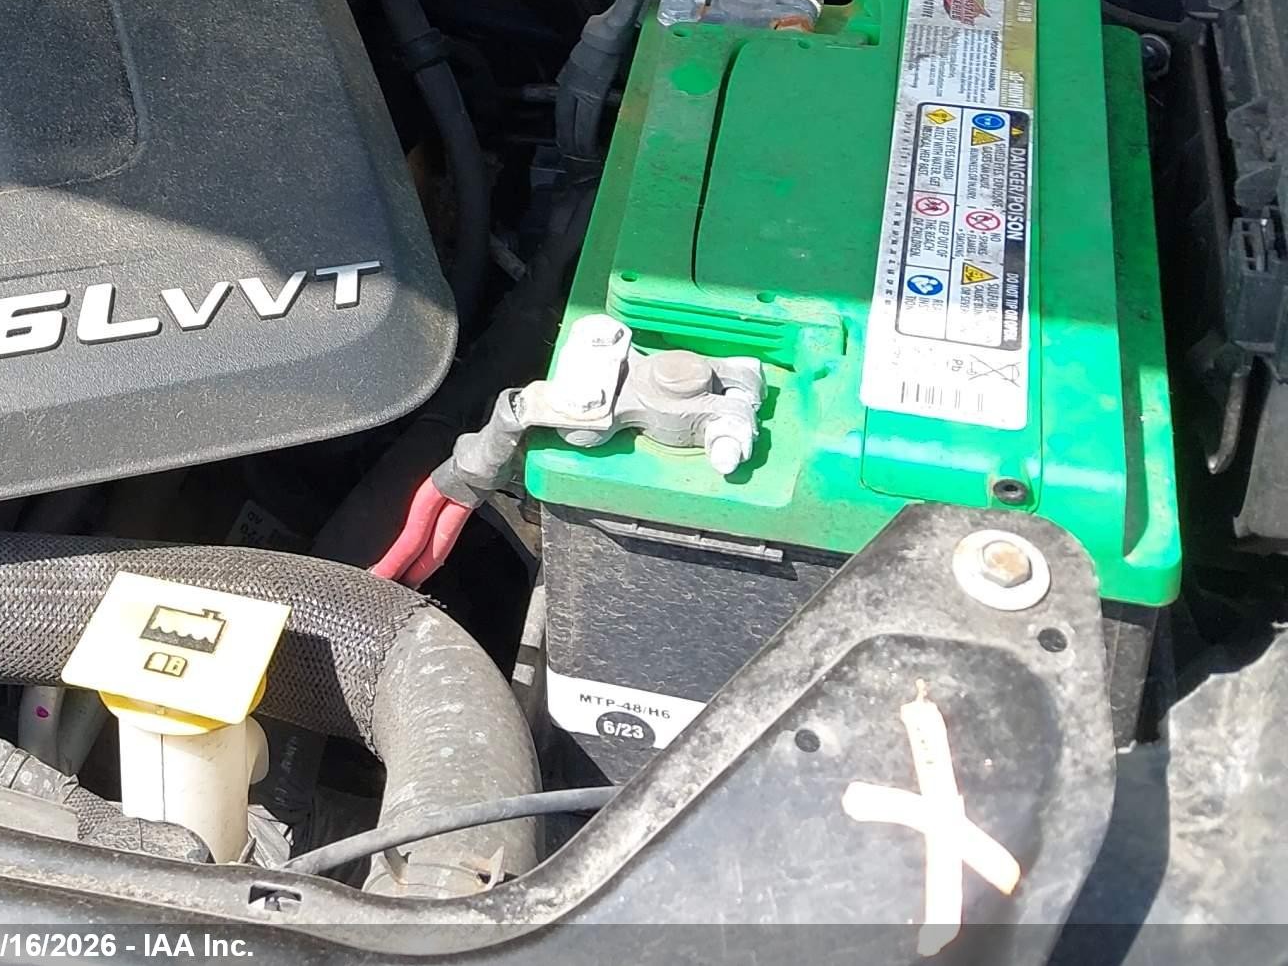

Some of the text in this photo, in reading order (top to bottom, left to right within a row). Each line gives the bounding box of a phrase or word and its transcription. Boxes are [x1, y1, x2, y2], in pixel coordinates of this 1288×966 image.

[918, 148, 929, 162] HELP
[932, 141, 942, 155] WITH
[944, 144, 955, 157] EYES
[994, 142, 1005, 161] SHIELD
[1006, 147, 1025, 241] DANGER/POISON
[912, 217, 923, 227] OF
[923, 219, 935, 251] THE REACH
[935, 220, 949, 258] KEEP OUT OF
[990, 232, 1001, 242] NO
[1006, 272, 1018, 283] DO
[161, 260, 383, 332] VVT
[1005, 283, 1018, 297] NOT
[1005, 298, 1017, 309] TIP
[579, 693, 671, 719] MTP-48/H6
[603, 720, 644, 739] 6/23
